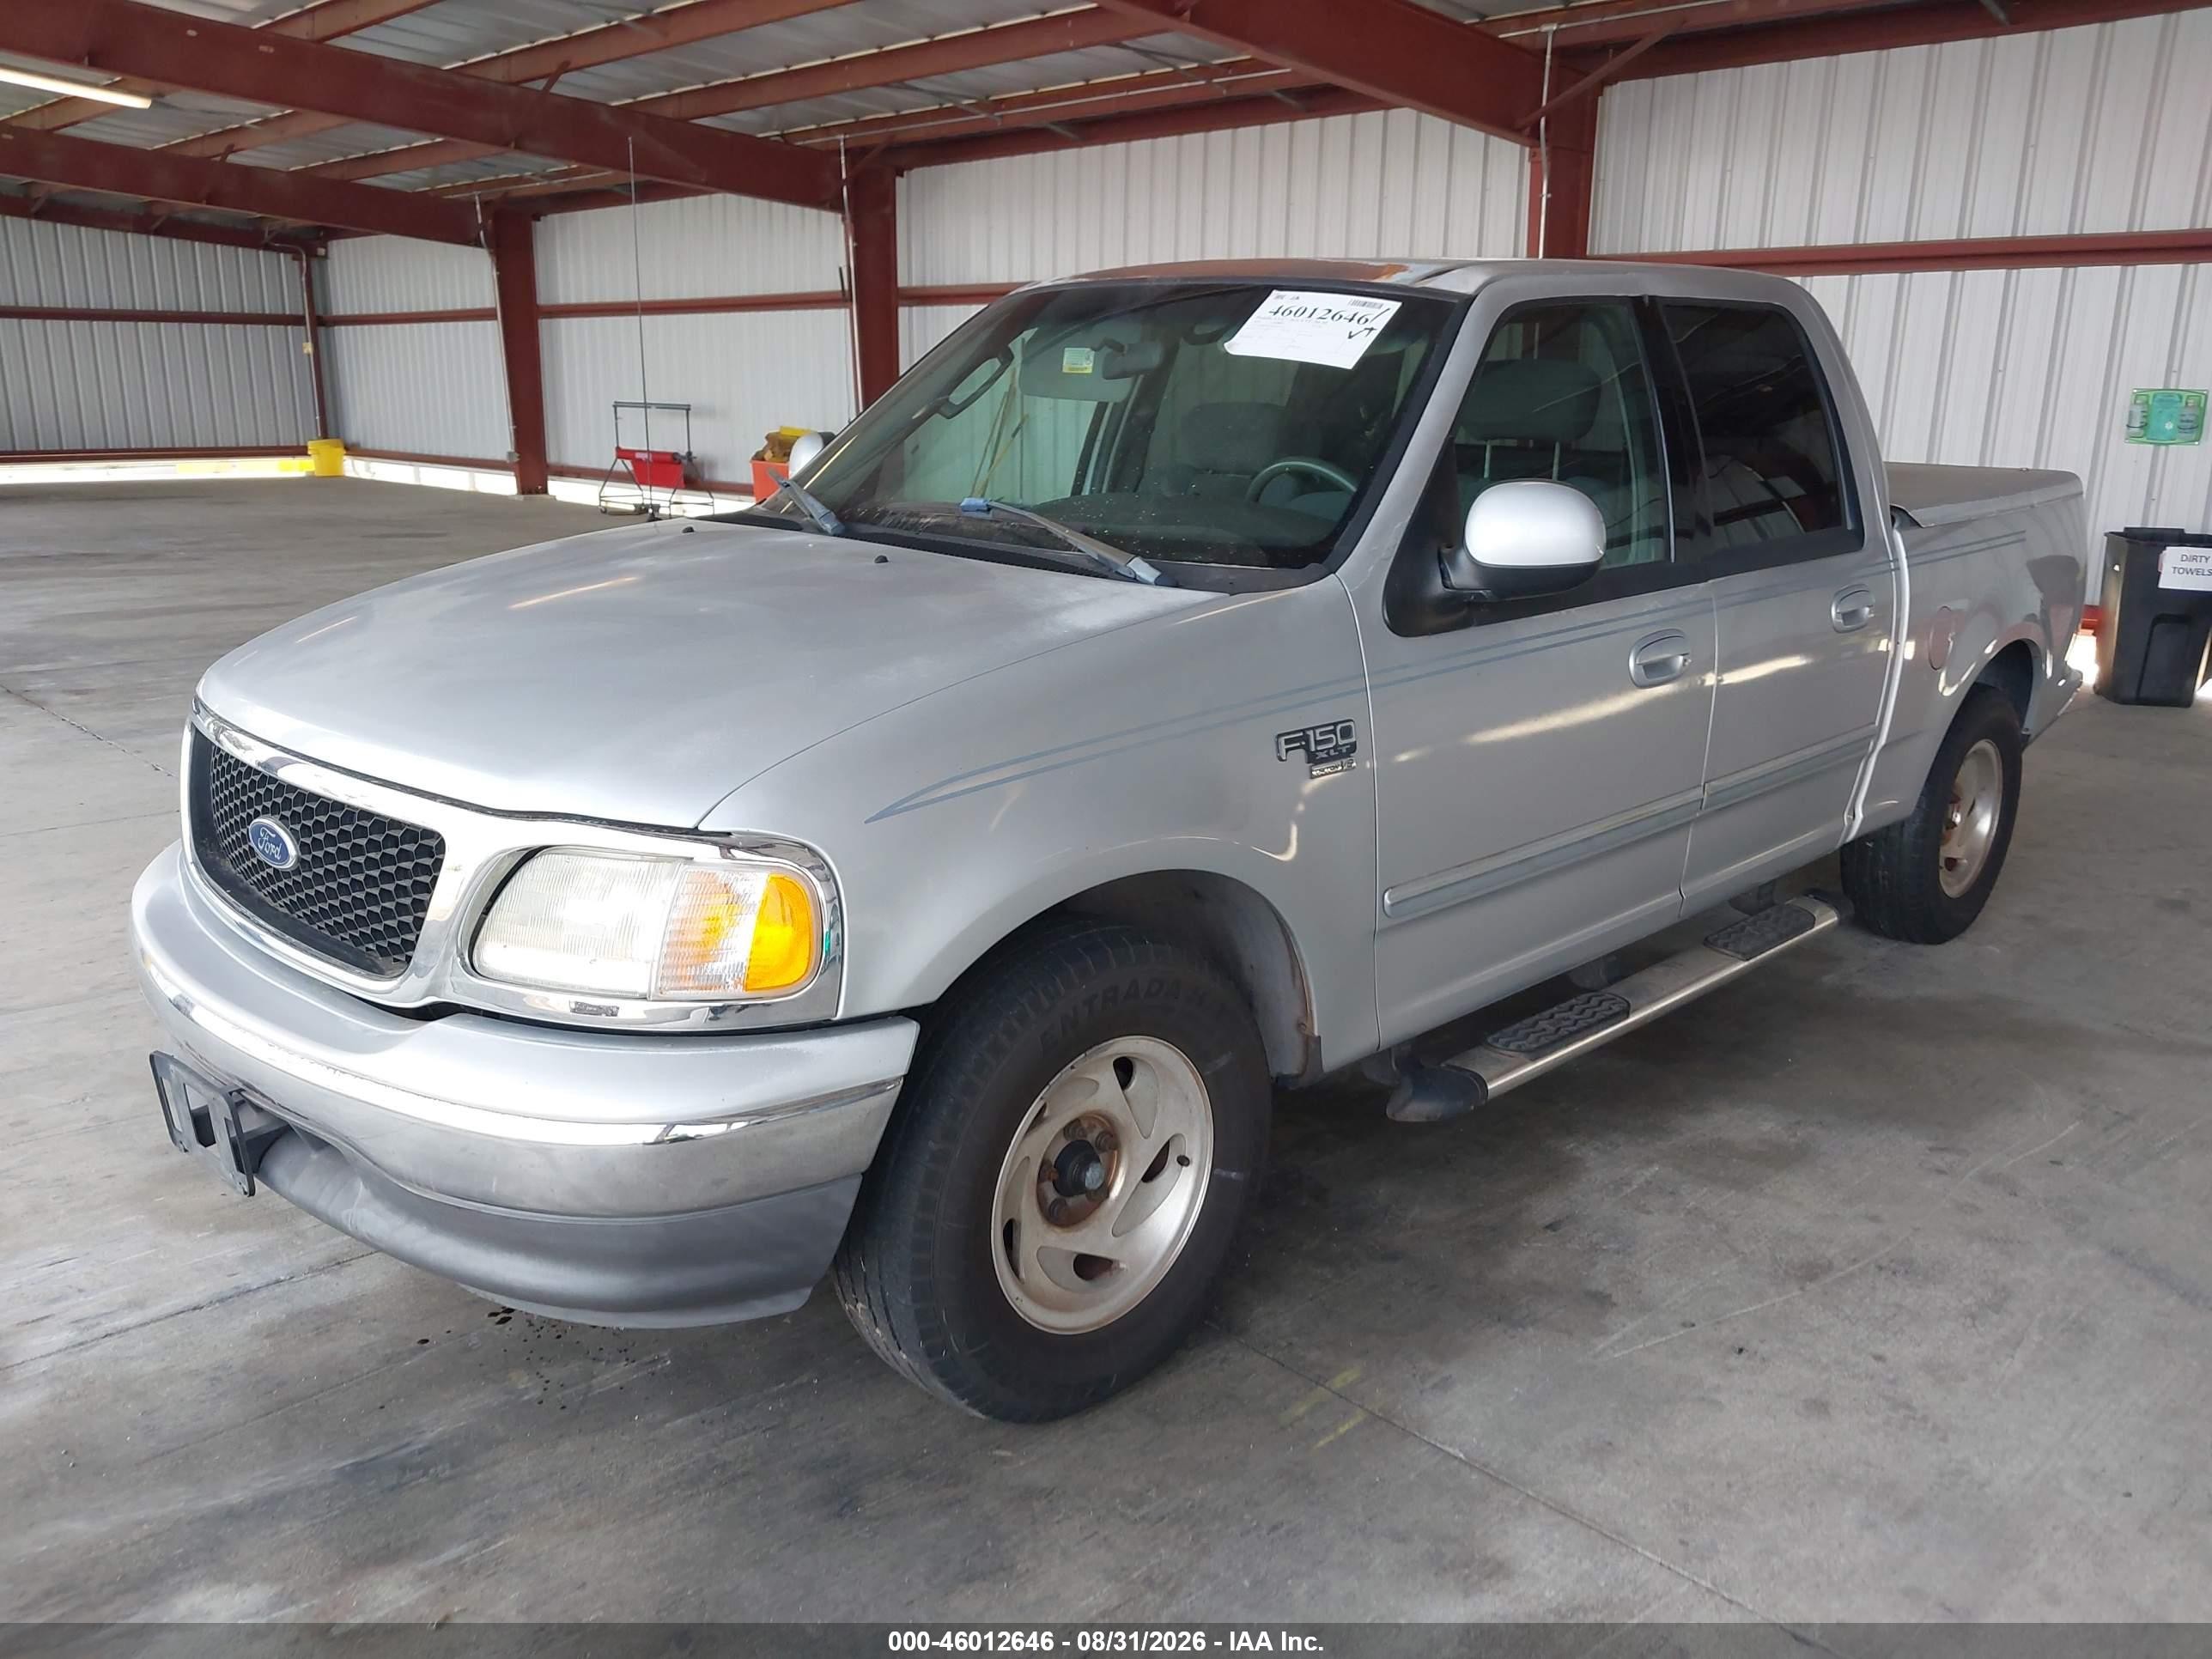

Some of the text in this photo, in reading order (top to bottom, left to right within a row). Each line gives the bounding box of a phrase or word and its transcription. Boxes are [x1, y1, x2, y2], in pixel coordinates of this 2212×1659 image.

[1269, 305, 1370, 325] 46012646
[2180, 554, 2211, 563] DIRTY
[2172, 567, 2212, 576] TOWELS
[1315, 745, 1351, 759] XLT
[258, 827, 283, 860] Ford
